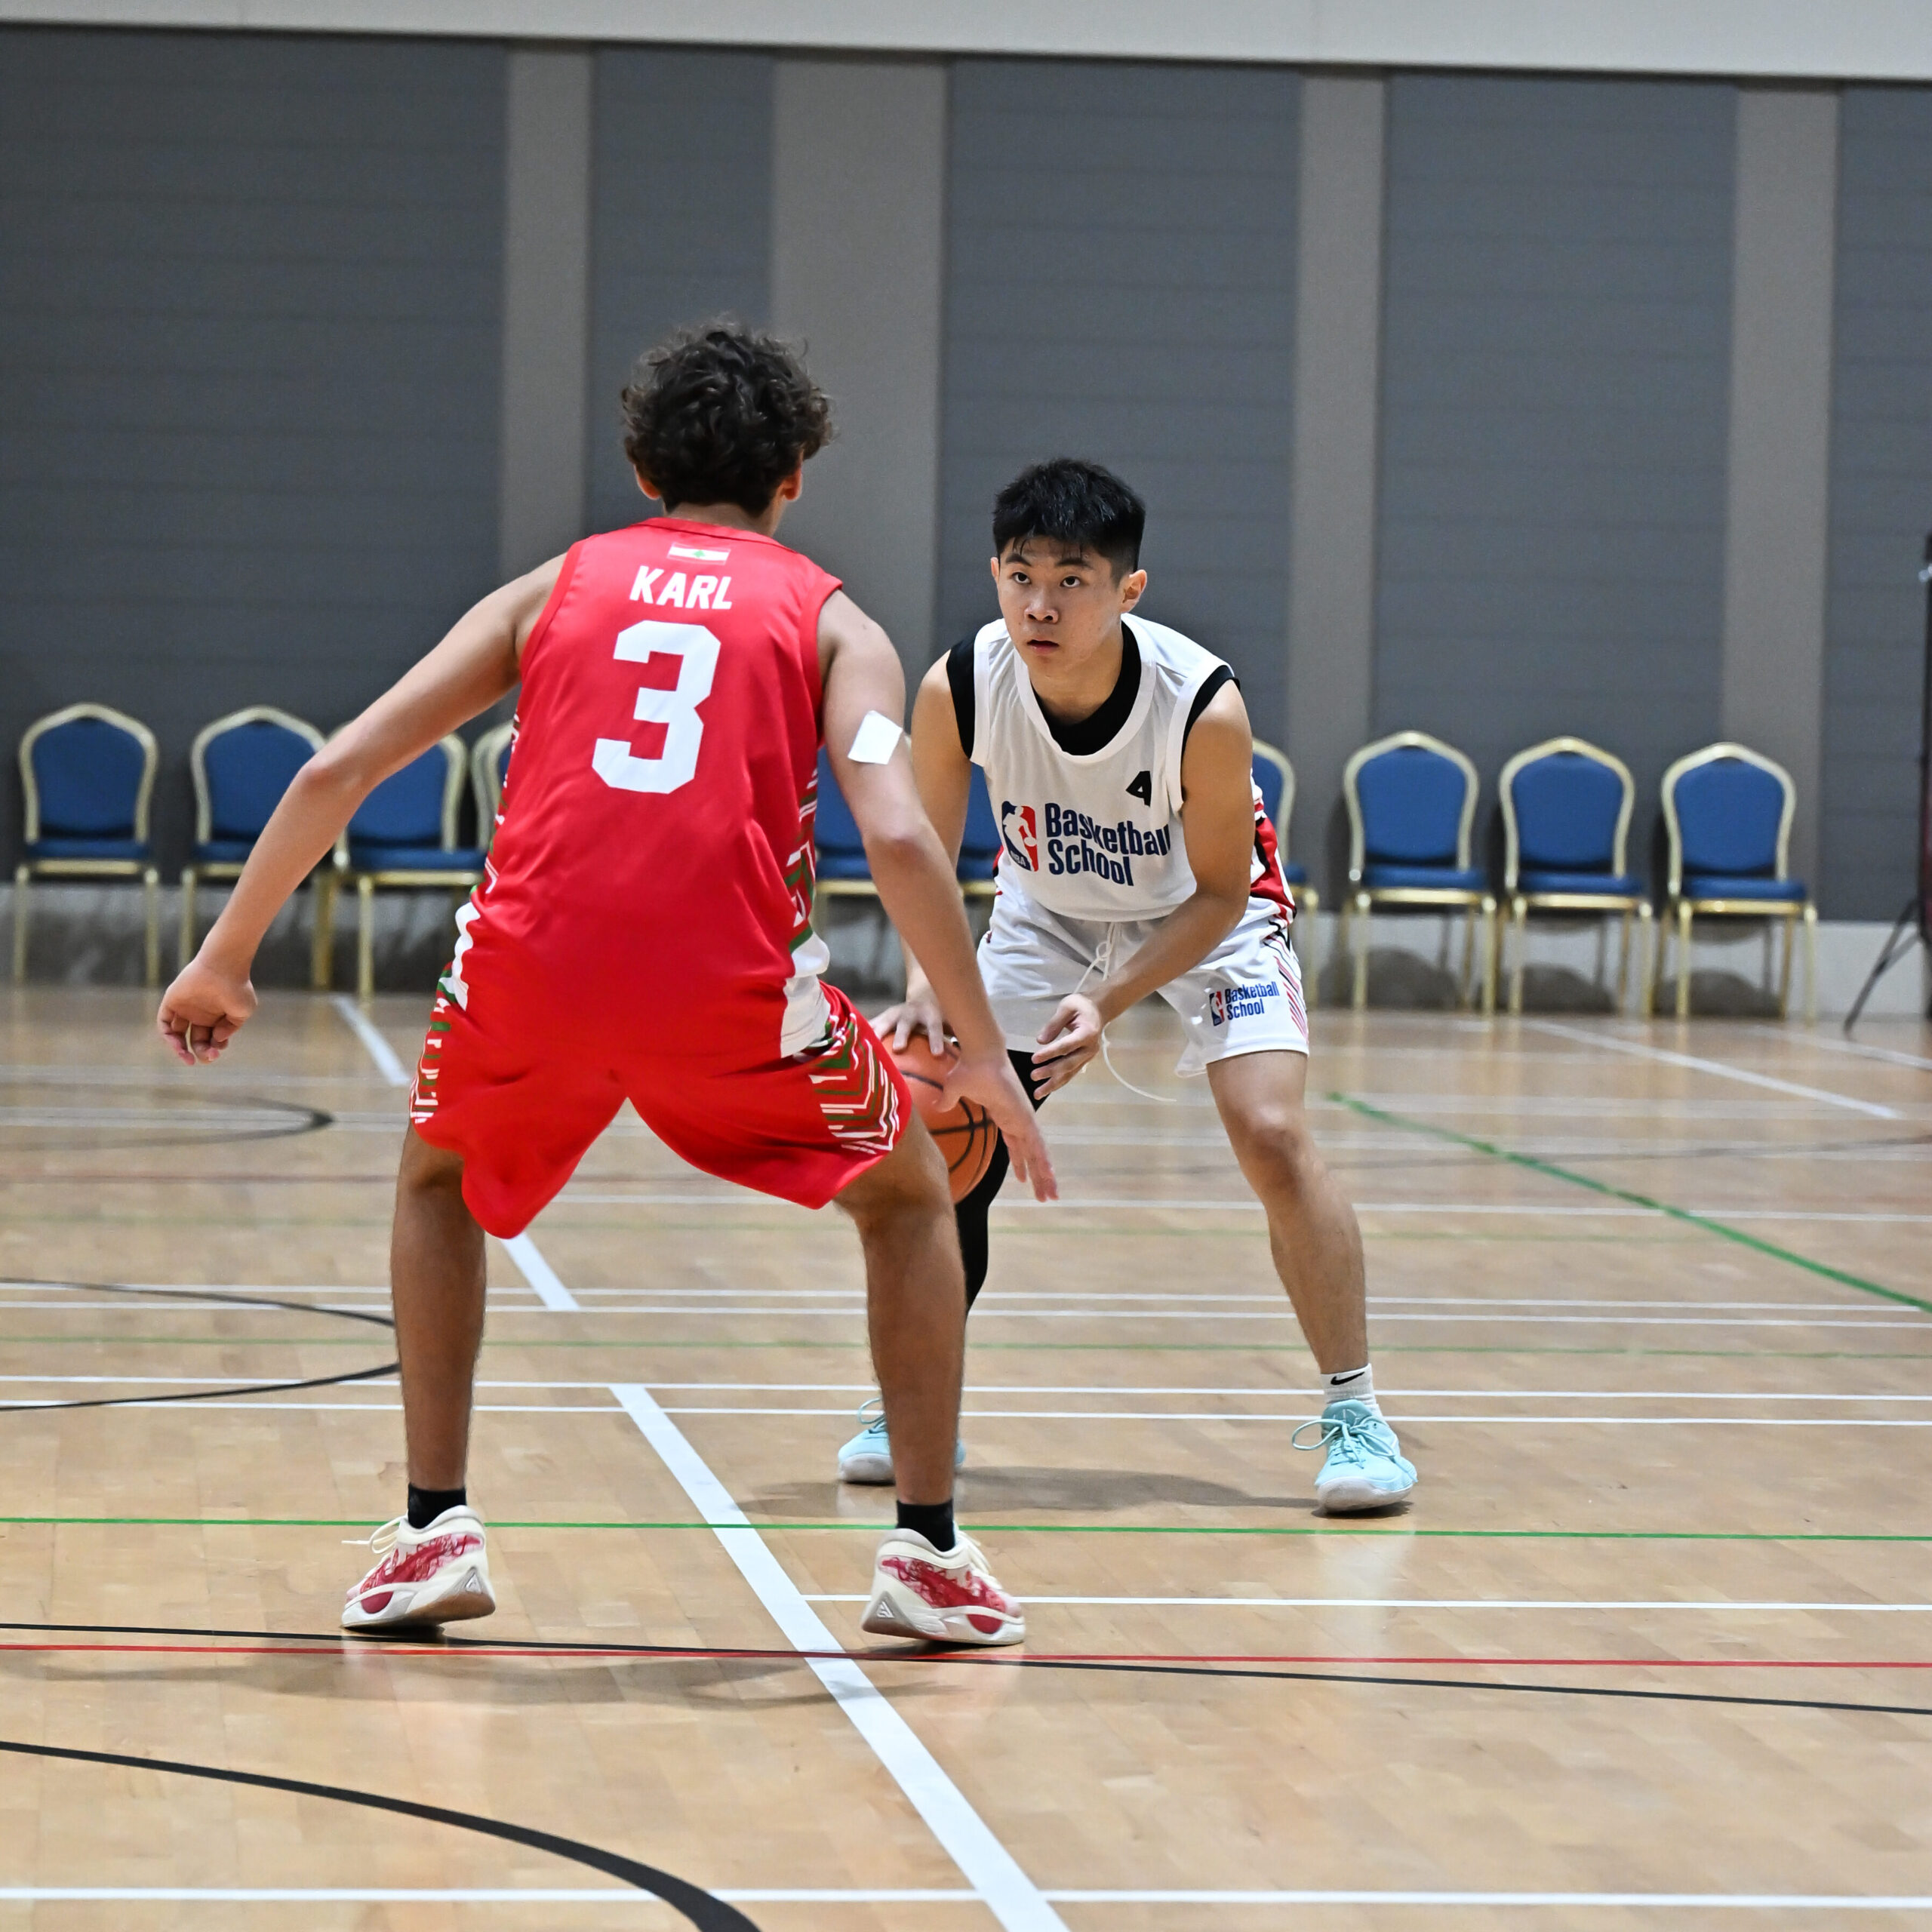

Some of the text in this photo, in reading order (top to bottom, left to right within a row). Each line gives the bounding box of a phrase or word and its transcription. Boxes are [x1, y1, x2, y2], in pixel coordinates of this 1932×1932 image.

[629, 565, 733, 610] KARL
[591, 620, 721, 795] 3
[1125, 770, 1152, 808] 4
[1044, 802, 1171, 857] Basketball
[1048, 838, 1134, 887] School
[1224, 981, 1280, 1004] Basketball
[1226, 998, 1265, 1021] School
